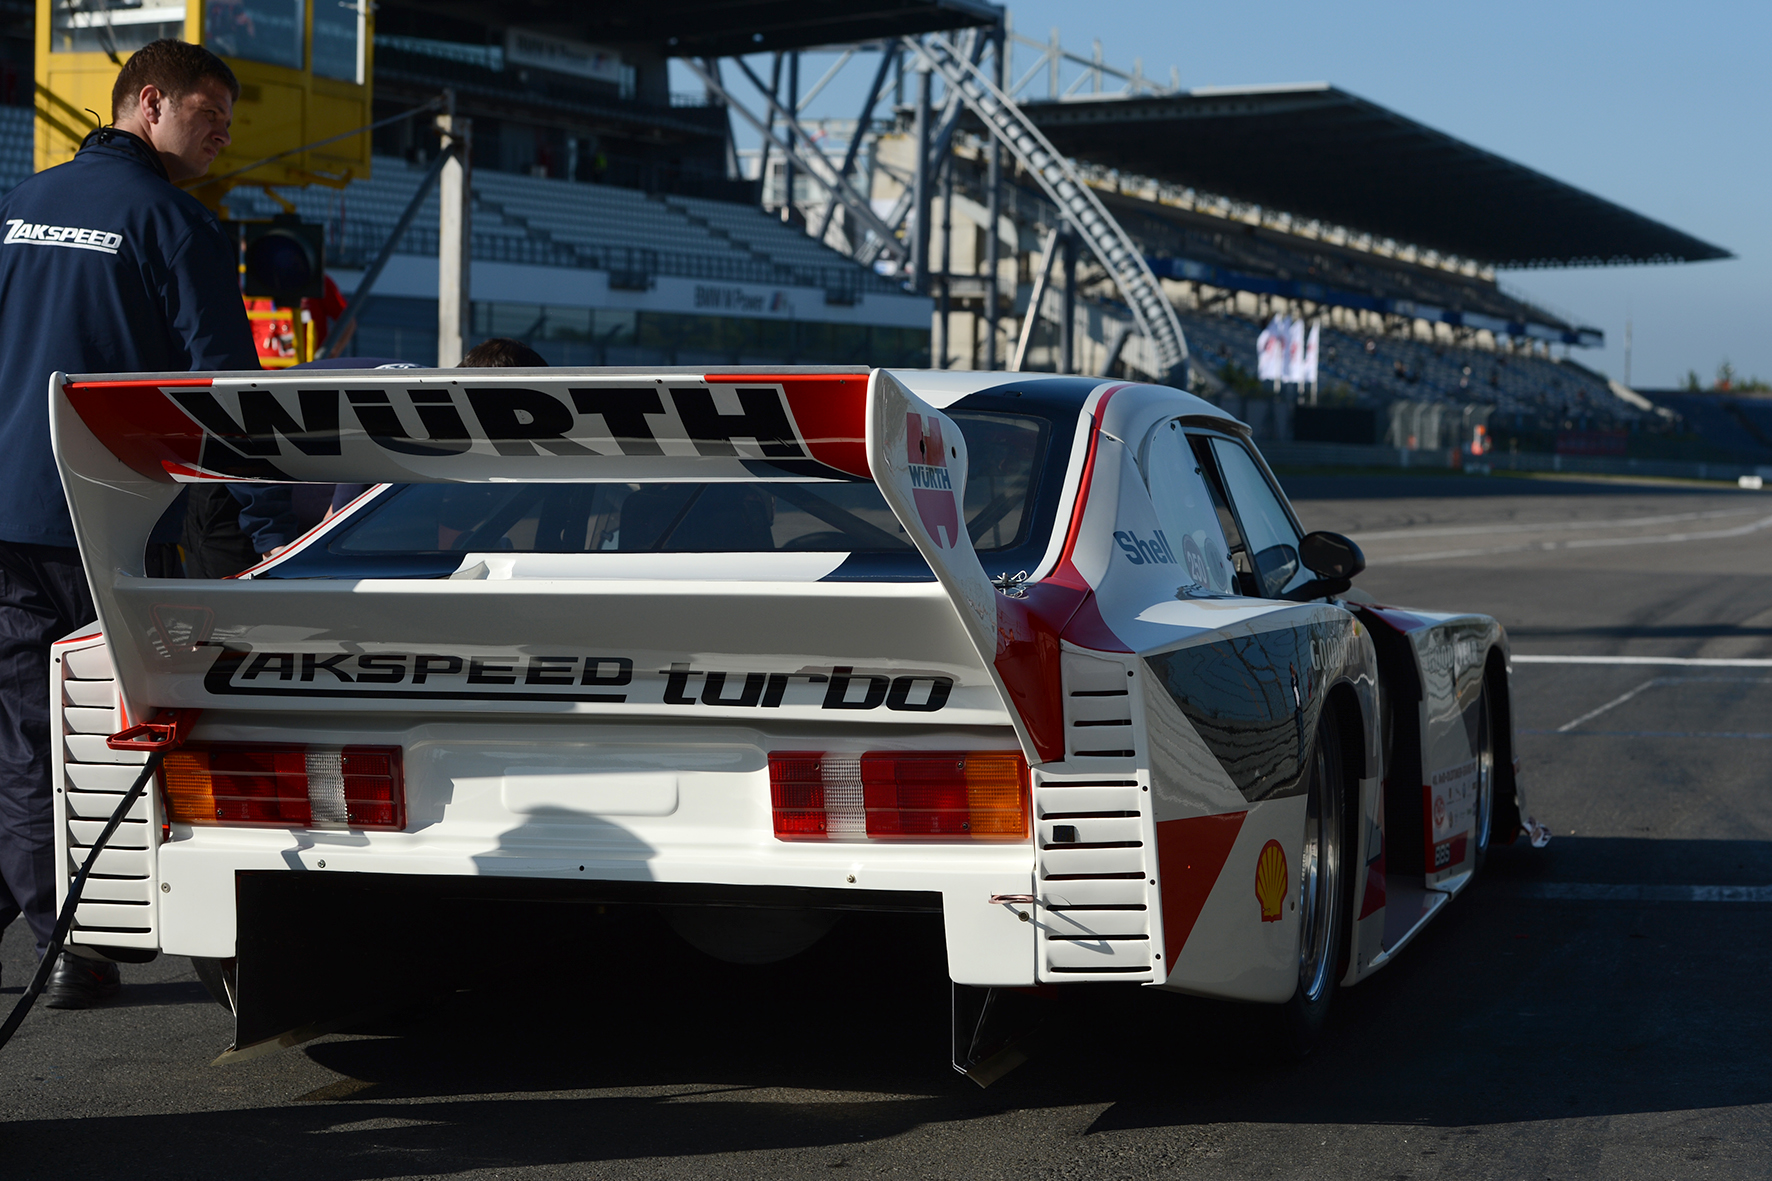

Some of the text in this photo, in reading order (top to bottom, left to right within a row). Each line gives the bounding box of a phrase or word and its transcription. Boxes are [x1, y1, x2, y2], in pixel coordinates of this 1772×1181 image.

[4, 219, 123, 254] ZAKSPEED
[168, 388, 808, 458] WÜRTH
[908, 465, 952, 489] WÜRTH
[1113, 529, 1178, 565] Shell
[1187, 550, 1207, 584] 250
[194, 641, 954, 712] ZAKSPEED turbo
[1435, 842, 1451, 868] BBS
